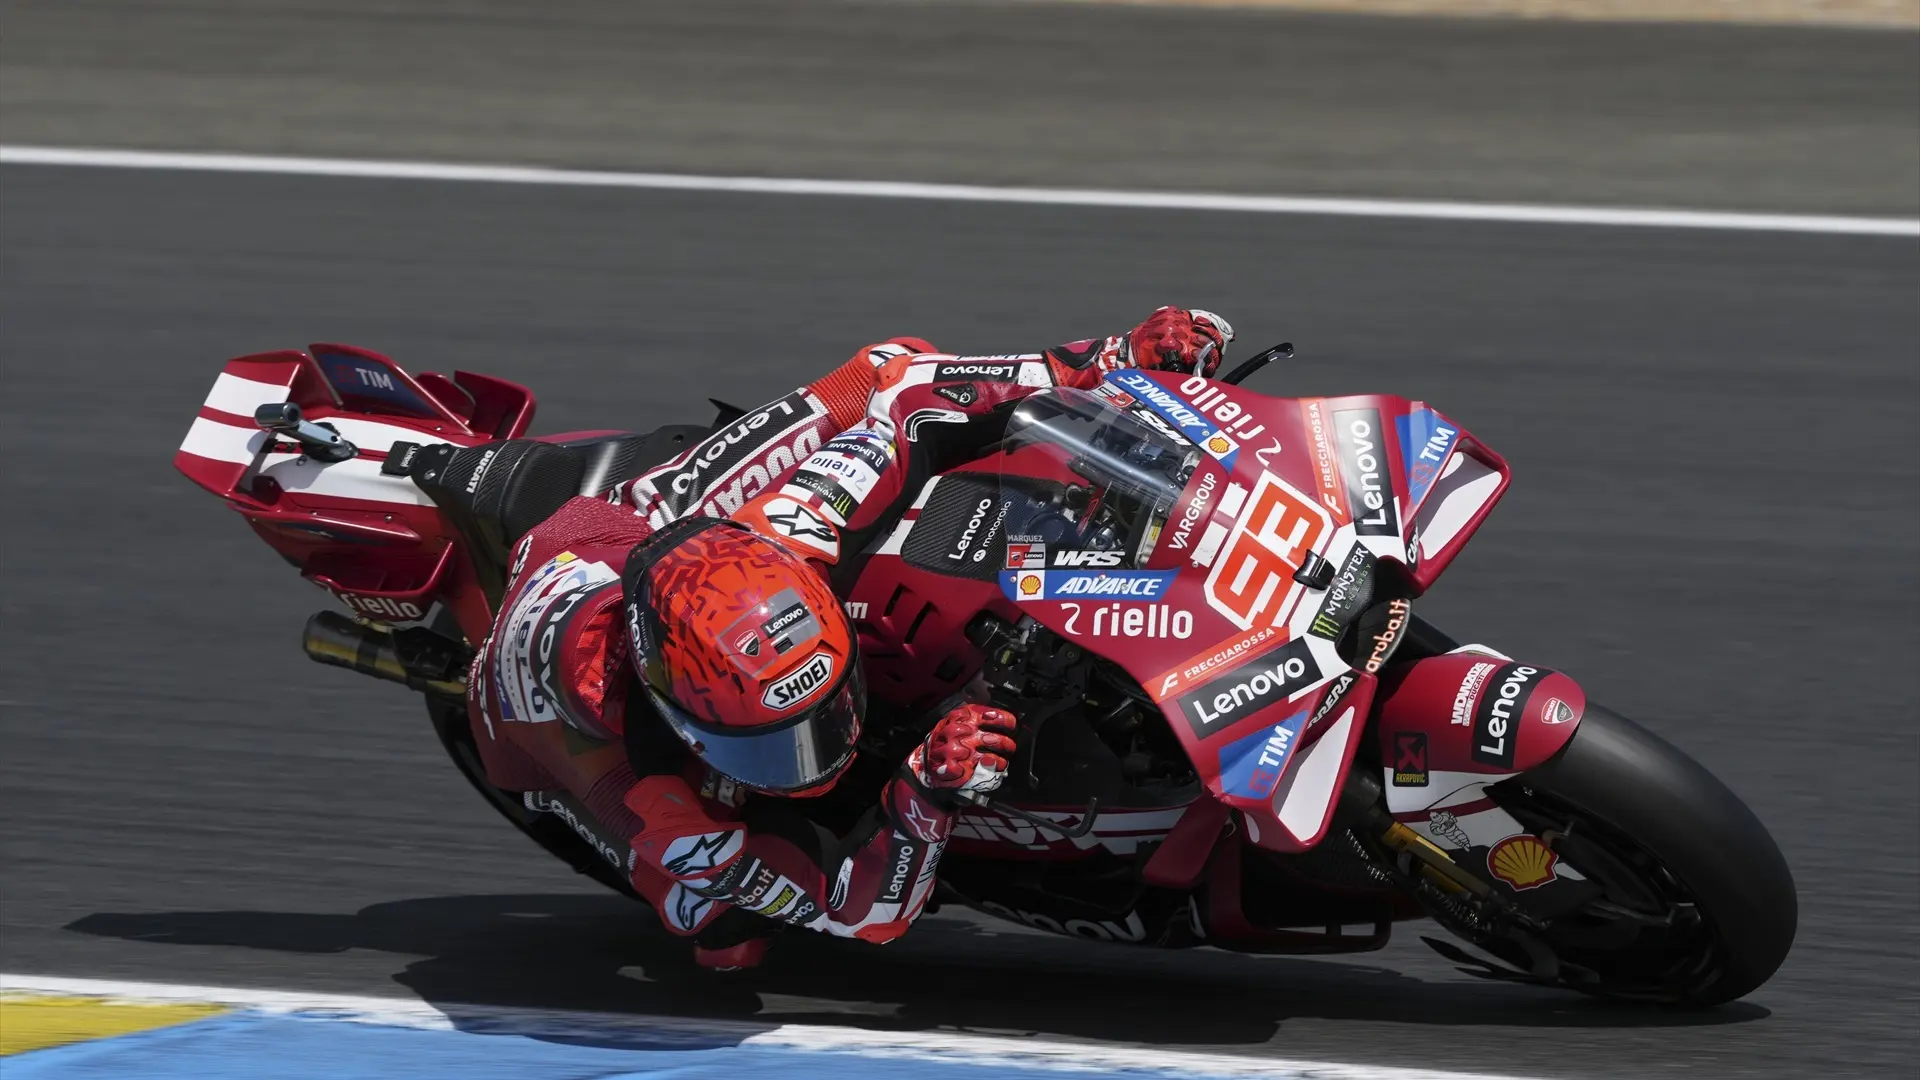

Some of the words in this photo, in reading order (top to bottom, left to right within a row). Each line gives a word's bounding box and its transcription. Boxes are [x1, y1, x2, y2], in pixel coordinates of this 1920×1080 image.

[355, 367, 394, 391] TIM
[942, 366, 1014, 377] Lenovo
[1123, 374, 1207, 427] ADVANCE
[1180, 376, 1265, 440] riello
[672, 401, 794, 495] Lenovo
[828, 442, 876, 460] LIMOLANE
[1311, 403, 1333, 488] FRECCIAROSSA
[1420, 427, 1455, 461] TIM
[466, 450, 494, 494] DUCATI
[703, 427, 821, 518] DUCA
[796, 477, 836, 501] MONSTER
[811, 457, 856, 478] riello
[1350, 419, 1387, 526] Lenovo
[948, 498, 991, 560] Lenovo
[983, 501, 1011, 547] motorola
[1168, 472, 1217, 549] VARGROUP
[1054, 551, 1125, 566] WRS
[1208, 476, 1330, 628] 93
[1055, 577, 1162, 595] ADVANCE
[1325, 547, 1369, 618] MONSTER
[1343, 563, 1372, 611] ENERGY
[340, 593, 422, 619] riello
[765, 608, 803, 634] Lenovo
[844, 602, 868, 619] ATI
[1093, 603, 1193, 639] riello
[627, 603, 648, 668] next
[1184, 627, 1275, 680] FRECCIAROSSA
[1365, 599, 1410, 673] aruba.it
[773, 659, 829, 705] SHOEI
[1193, 657, 1305, 724] Lenovo
[1307, 675, 1353, 729] RRERA
[1470, 674, 1484, 700] DUCATI
[1481, 666, 1537, 755] Lenovo
[1544, 699, 1556, 721] DUCATI
[1258, 725, 1293, 767] TIM
[736, 868, 775, 906] uba.it
[883, 845, 914, 900] Lenovo
